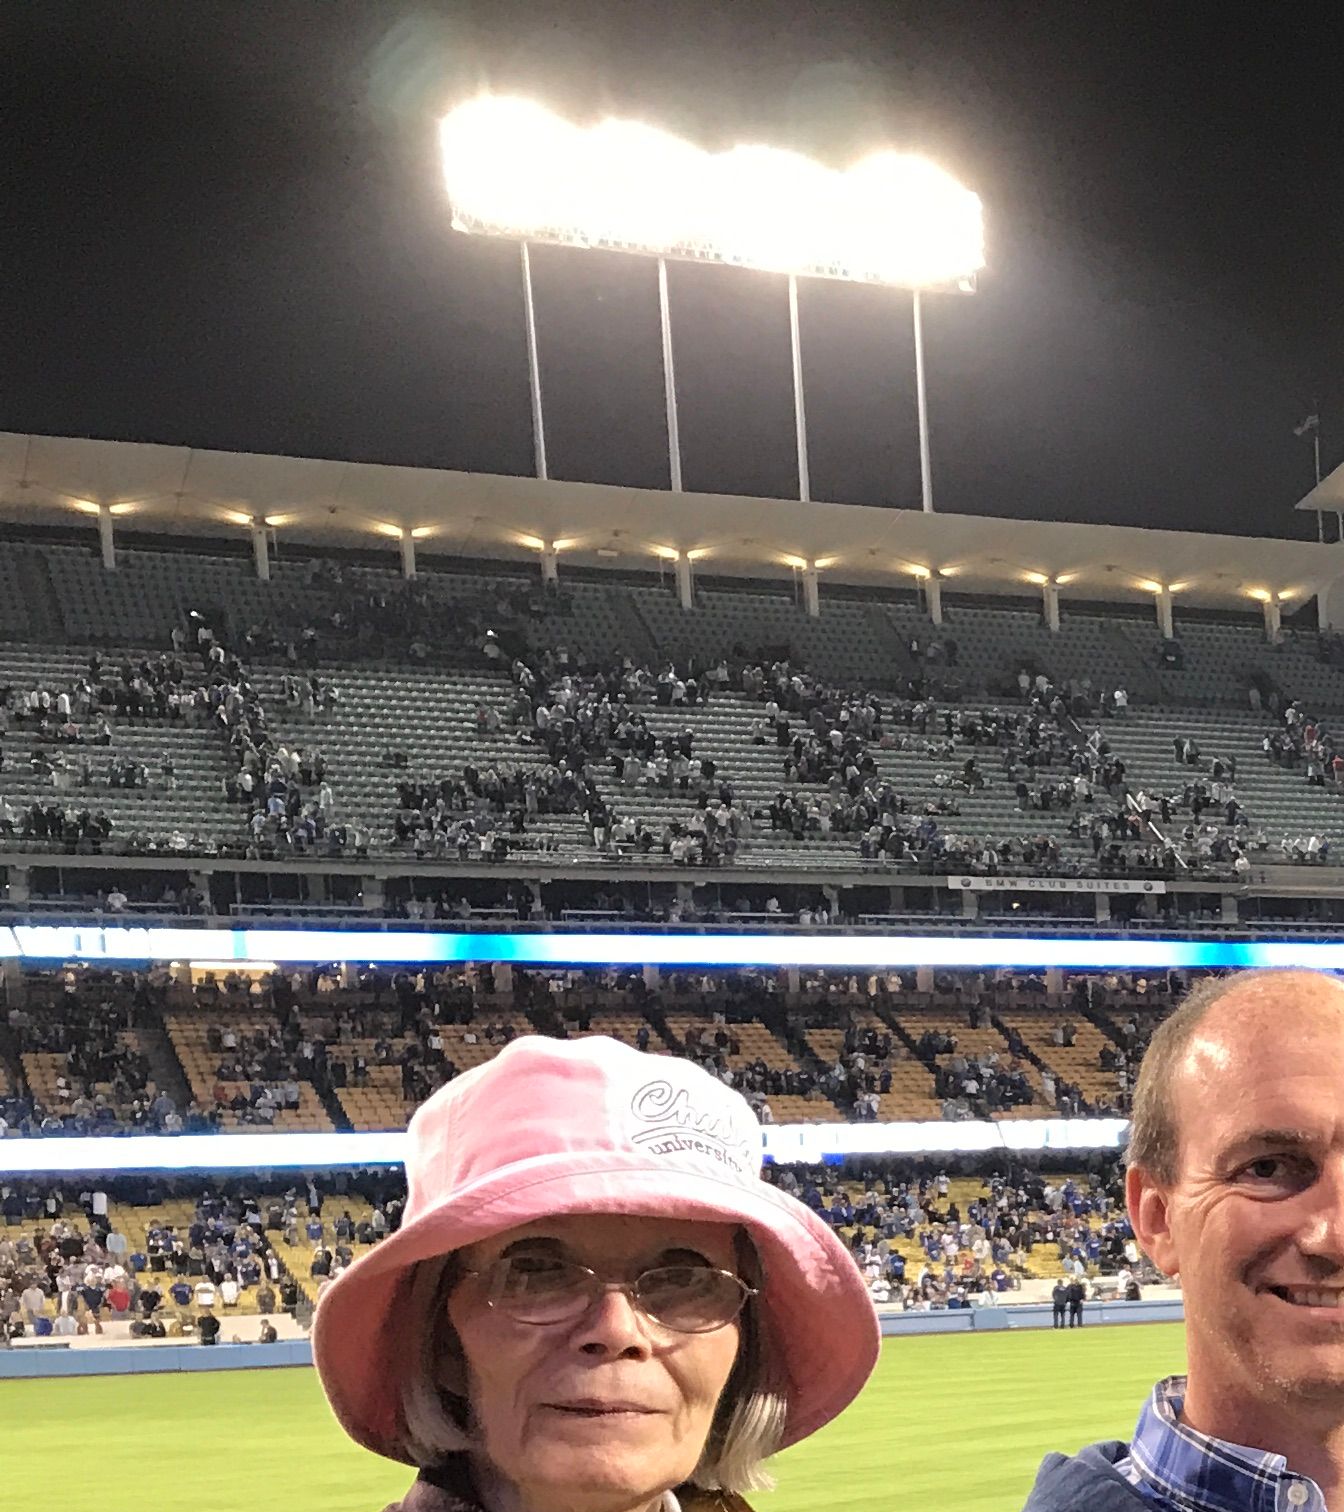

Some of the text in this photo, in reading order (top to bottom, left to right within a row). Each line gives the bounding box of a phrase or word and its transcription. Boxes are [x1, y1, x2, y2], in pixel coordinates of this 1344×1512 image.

[985, 878, 1130, 890] BMW CLUB SUITES
